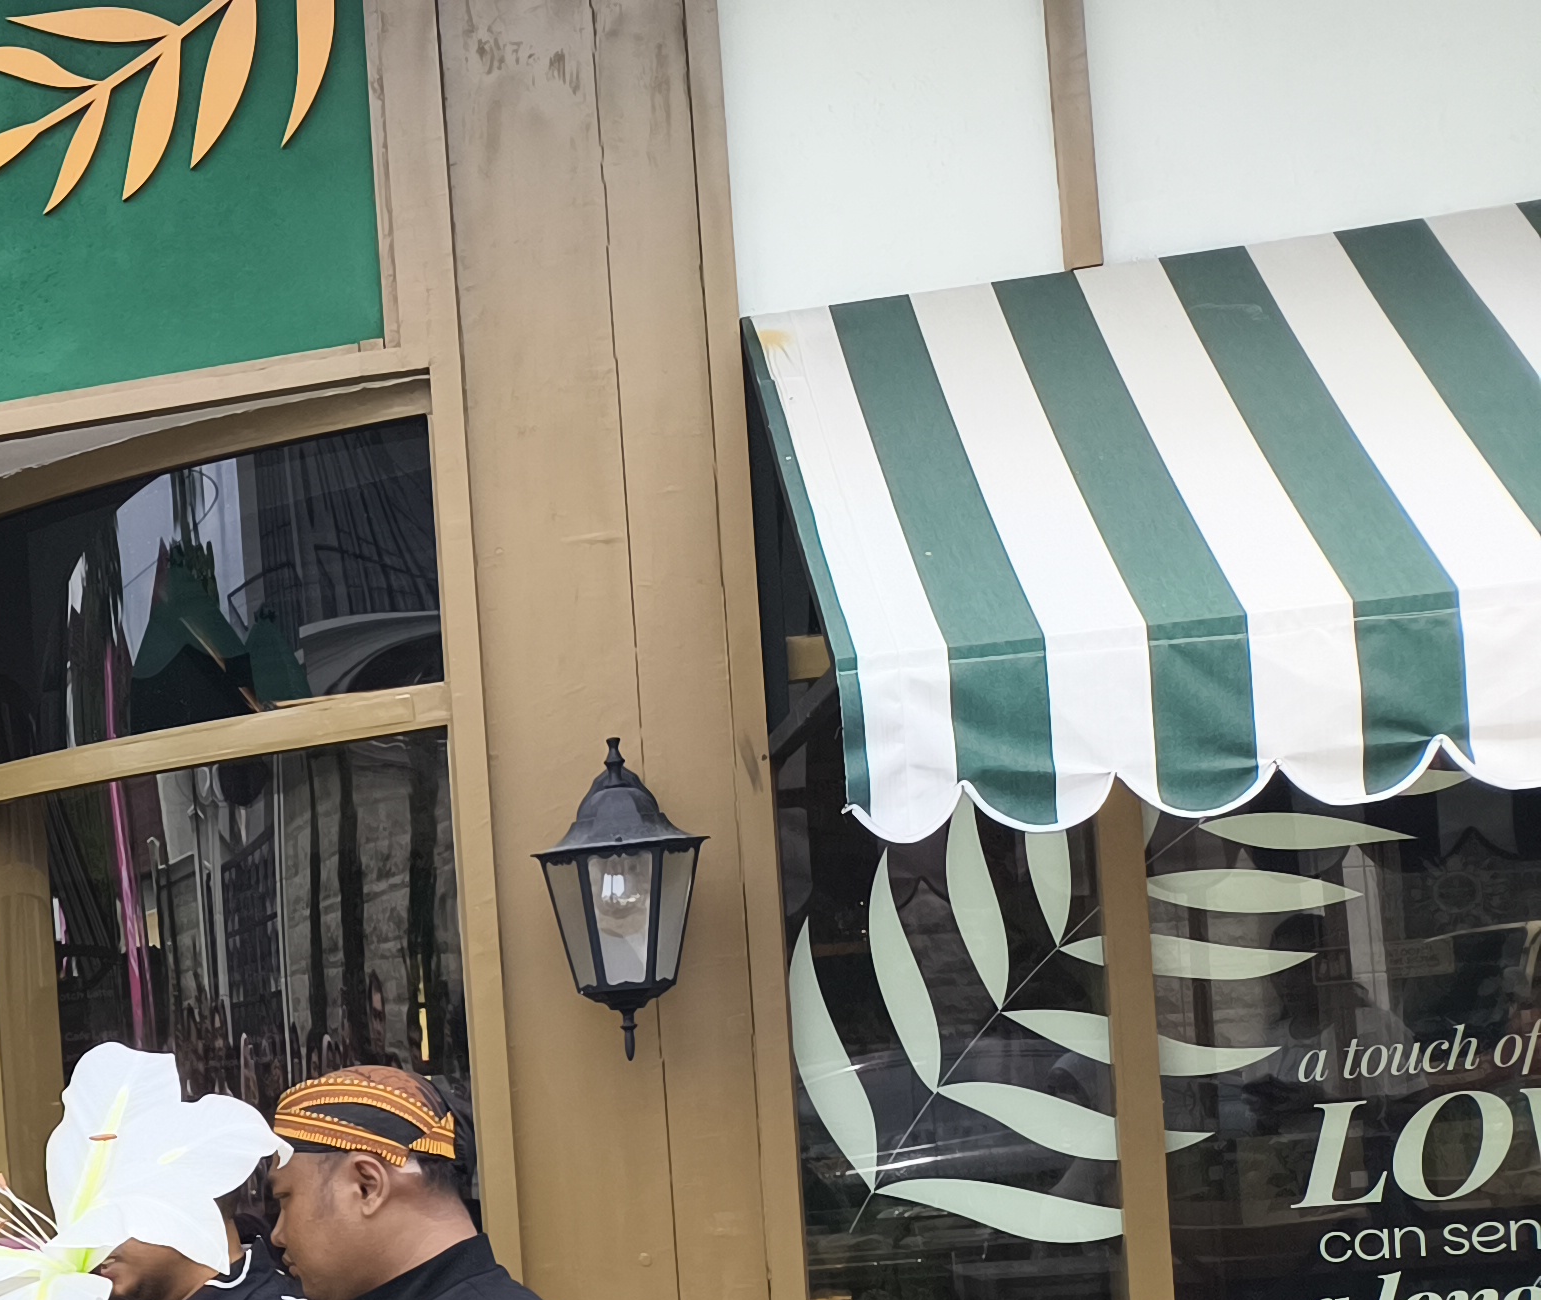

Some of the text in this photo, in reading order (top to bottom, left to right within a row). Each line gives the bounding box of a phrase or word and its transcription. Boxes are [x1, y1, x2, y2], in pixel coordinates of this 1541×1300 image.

[1298, 1049, 1328, 1083] a
[1342, 1023, 1480, 1079] touch
[1290, 1087, 1541, 1209] LO
[1319, 1218, 1541, 1263] can sen
